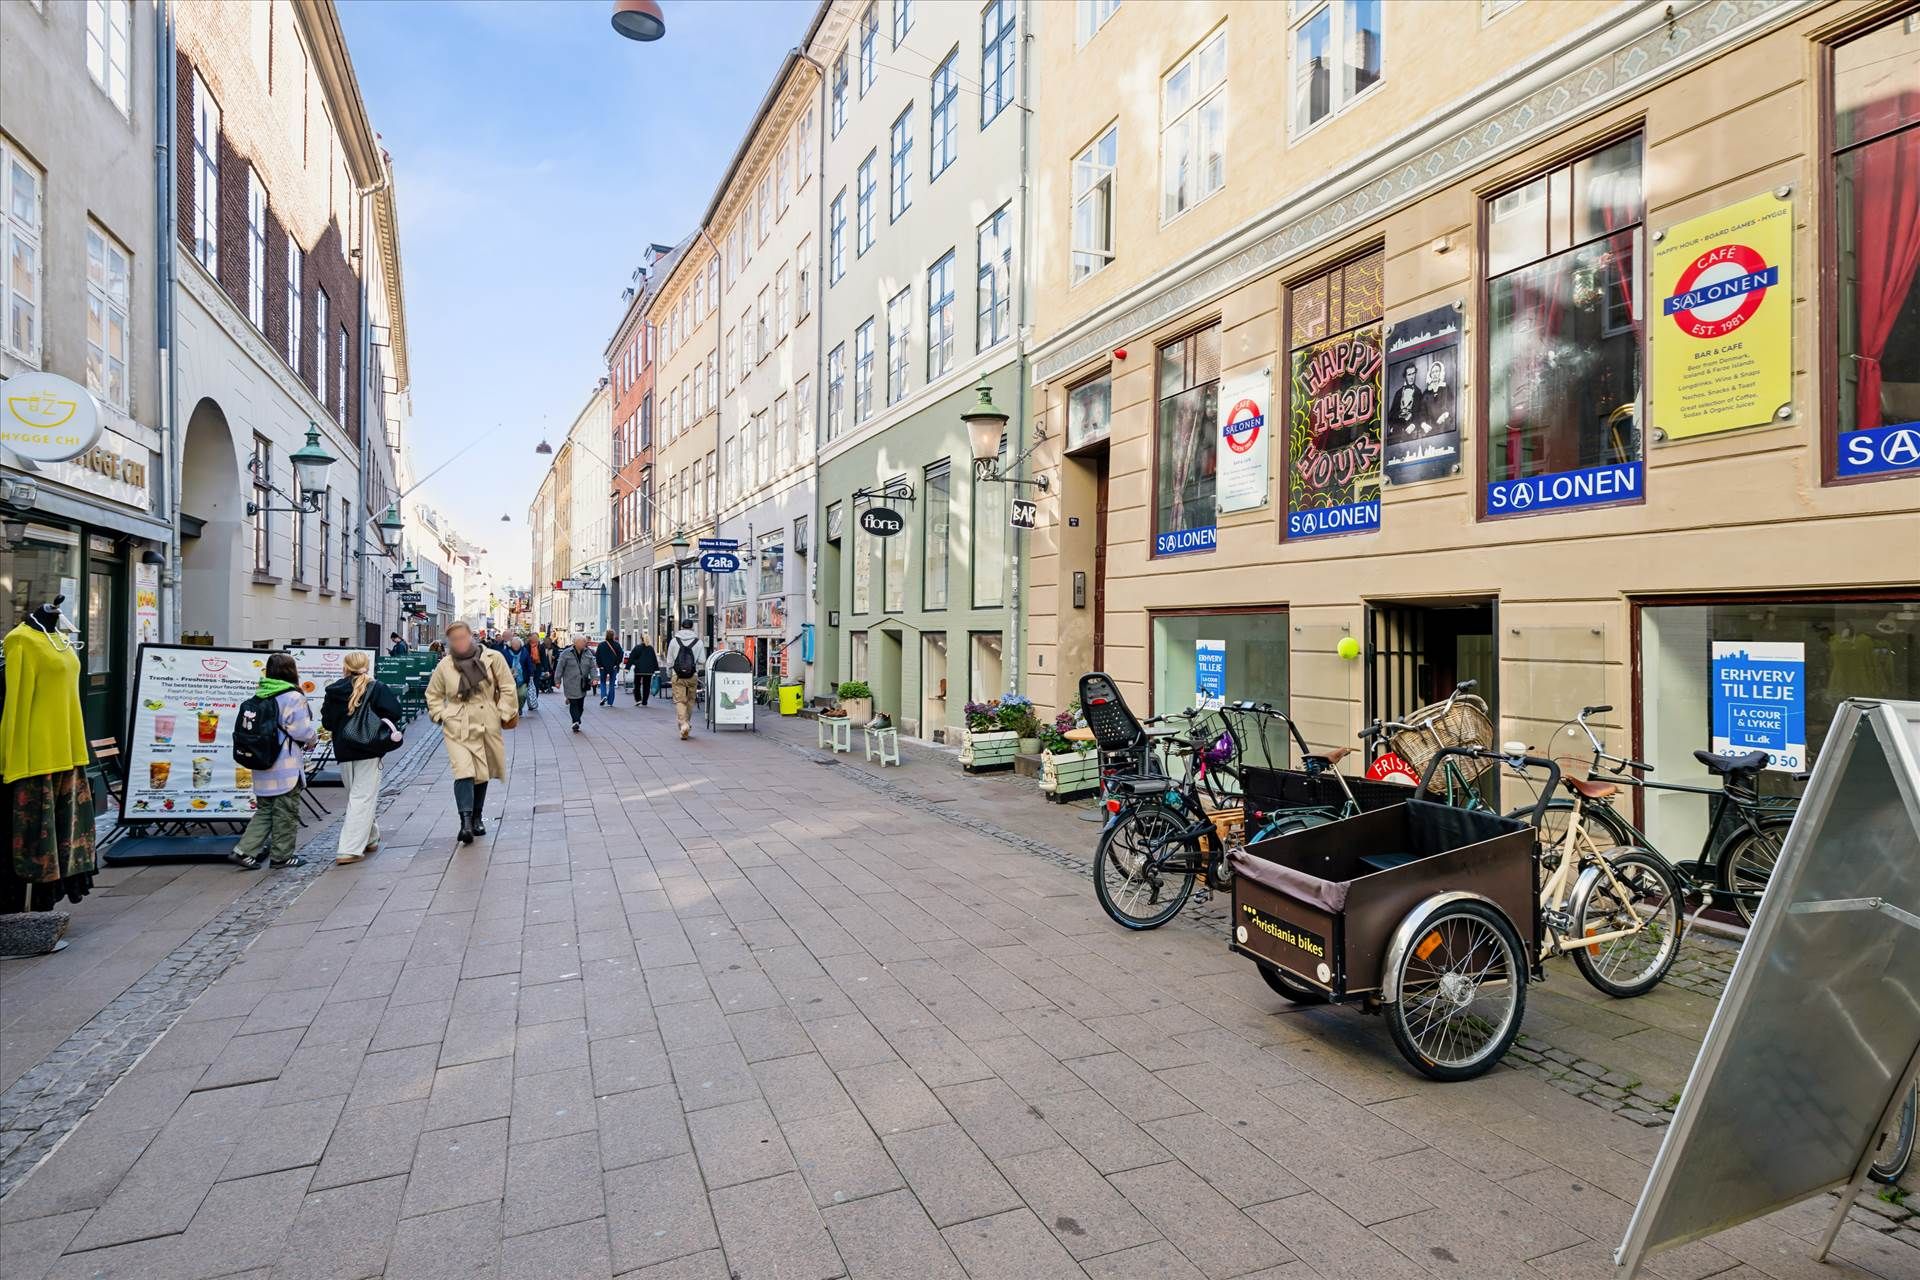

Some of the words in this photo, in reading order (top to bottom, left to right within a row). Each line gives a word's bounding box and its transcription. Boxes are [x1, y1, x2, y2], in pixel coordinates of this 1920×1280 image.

[1680, 239, 1699, 250] HOUR
[1704, 229, 1729, 241] BOARD
[1730, 220, 1756, 232] GAMES
[1698, 246, 1736, 269] CAFÉ
[1672, 272, 1768, 311] SALONEN
[1692, 324, 1716, 335] EST.
[1694, 350, 1712, 360] BAR
[1300, 340, 1382, 396] HAPPY
[1703, 360, 1718, 368] from
[1708, 387, 1730, 396] Snacks
[1225, 416, 1261, 435] SALONEN
[0, 432, 49, 445] HYGGE
[56, 434, 80, 445] CHI
[1296, 434, 1381, 489] HOUR
[122, 458, 145, 488] CHI
[1492, 468, 1635, 509] SALONEN
[864, 514, 900, 531] fiona
[1013, 505, 1036, 524] BAR
[1291, 504, 1378, 534] SALONEN
[1158, 529, 1216, 552] SALONEN
[707, 557, 733, 568] ZaRa
[1198, 654, 1223, 662] ERHVERV
[1199, 663, 1208, 671] TIL
[1209, 663, 1223, 672] LEJE
[1720, 668, 1795, 683] ERHVERV
[1721, 683, 1749, 698] TIL
[1753, 685, 1795, 701] LEJE
[1733, 709, 1747, 717] LA
[1749, 710, 1781, 720] COUR
[1738, 718, 1745, 727] &
[1748, 719, 1782, 730] LYKKE
[1780, 756, 1798, 768] 50
[1298, 934, 1324, 958] bikes
